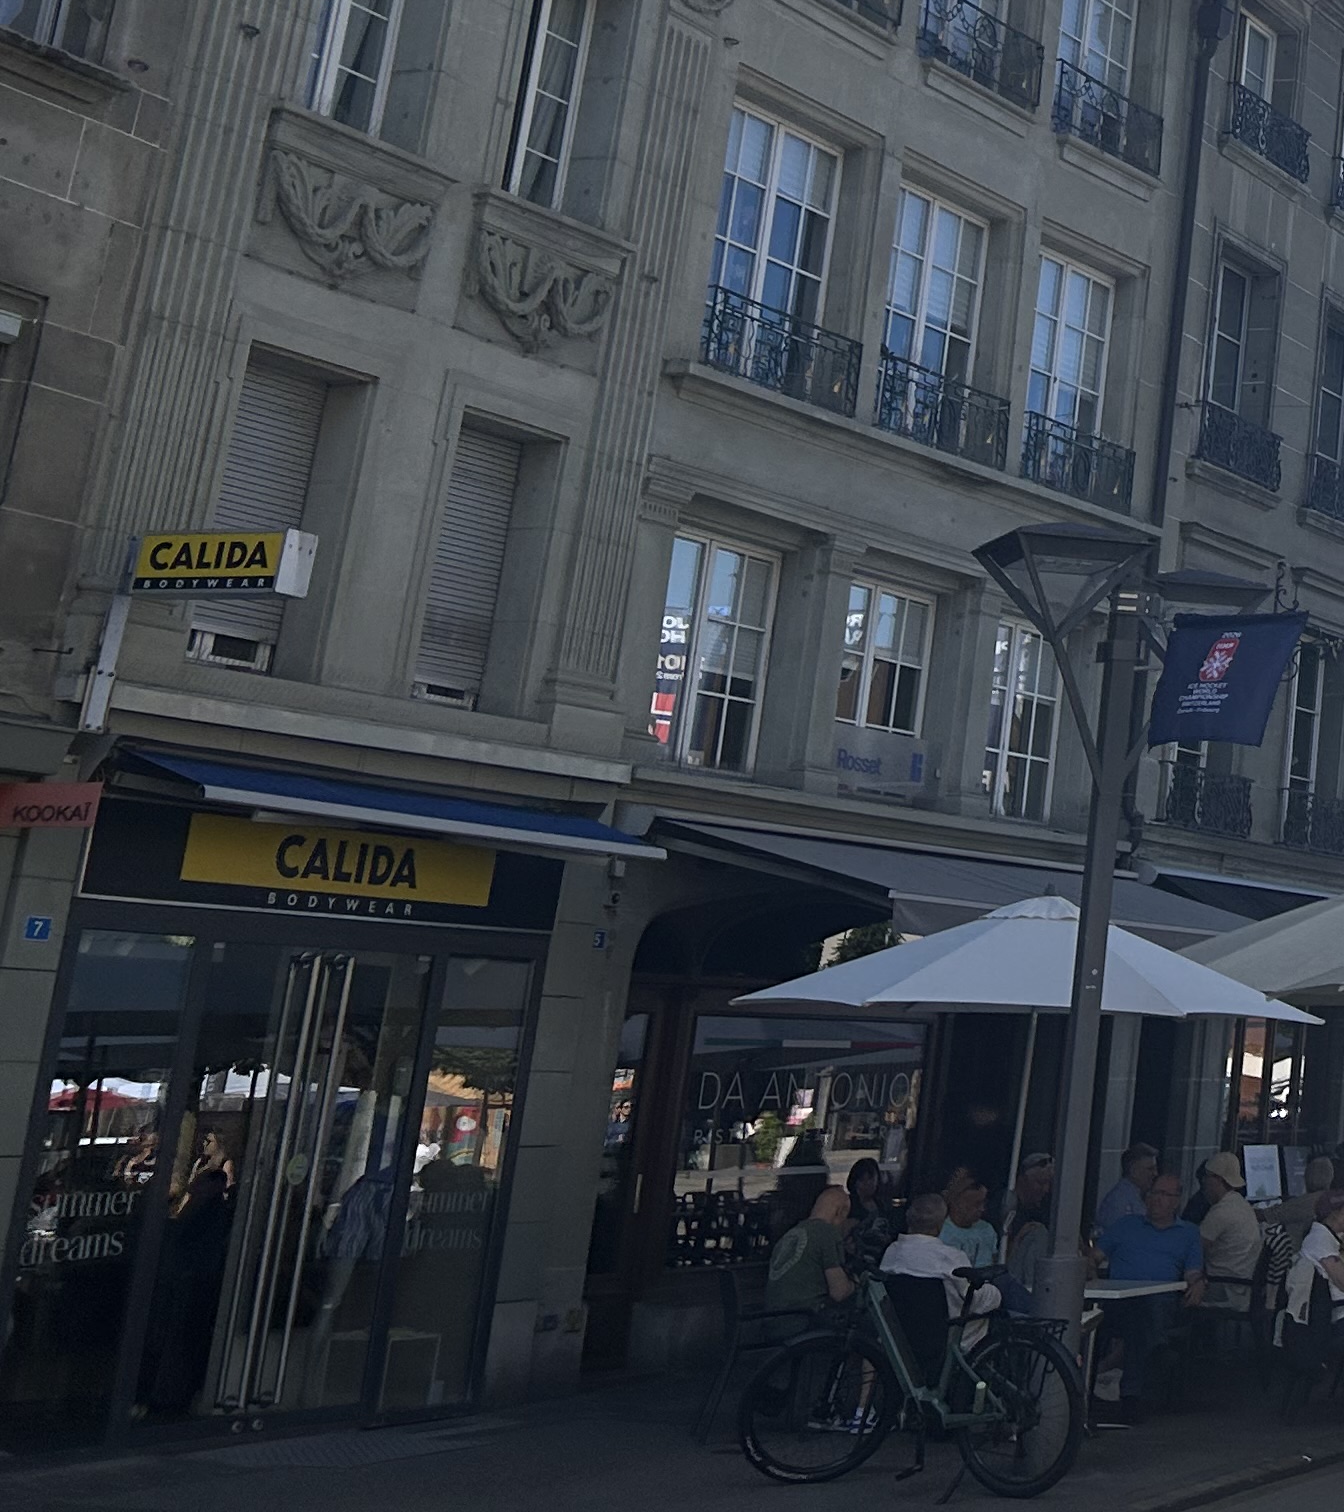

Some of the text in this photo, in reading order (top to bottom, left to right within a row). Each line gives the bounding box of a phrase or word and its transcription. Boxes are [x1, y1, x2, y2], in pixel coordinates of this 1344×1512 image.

[149, 541, 268, 571] CALIDA
[143, 577, 266, 589] BODYWEAR
[837, 747, 883, 777] Rosset
[12, 800, 93, 824] KOOKAÏ
[275, 834, 418, 890] CALIDA
[267, 891, 413, 917] BODYWEAR
[32, 920, 44, 938] 7
[698, 1071, 745, 1110] DA
[18, 1228, 125, 1268] dreams
